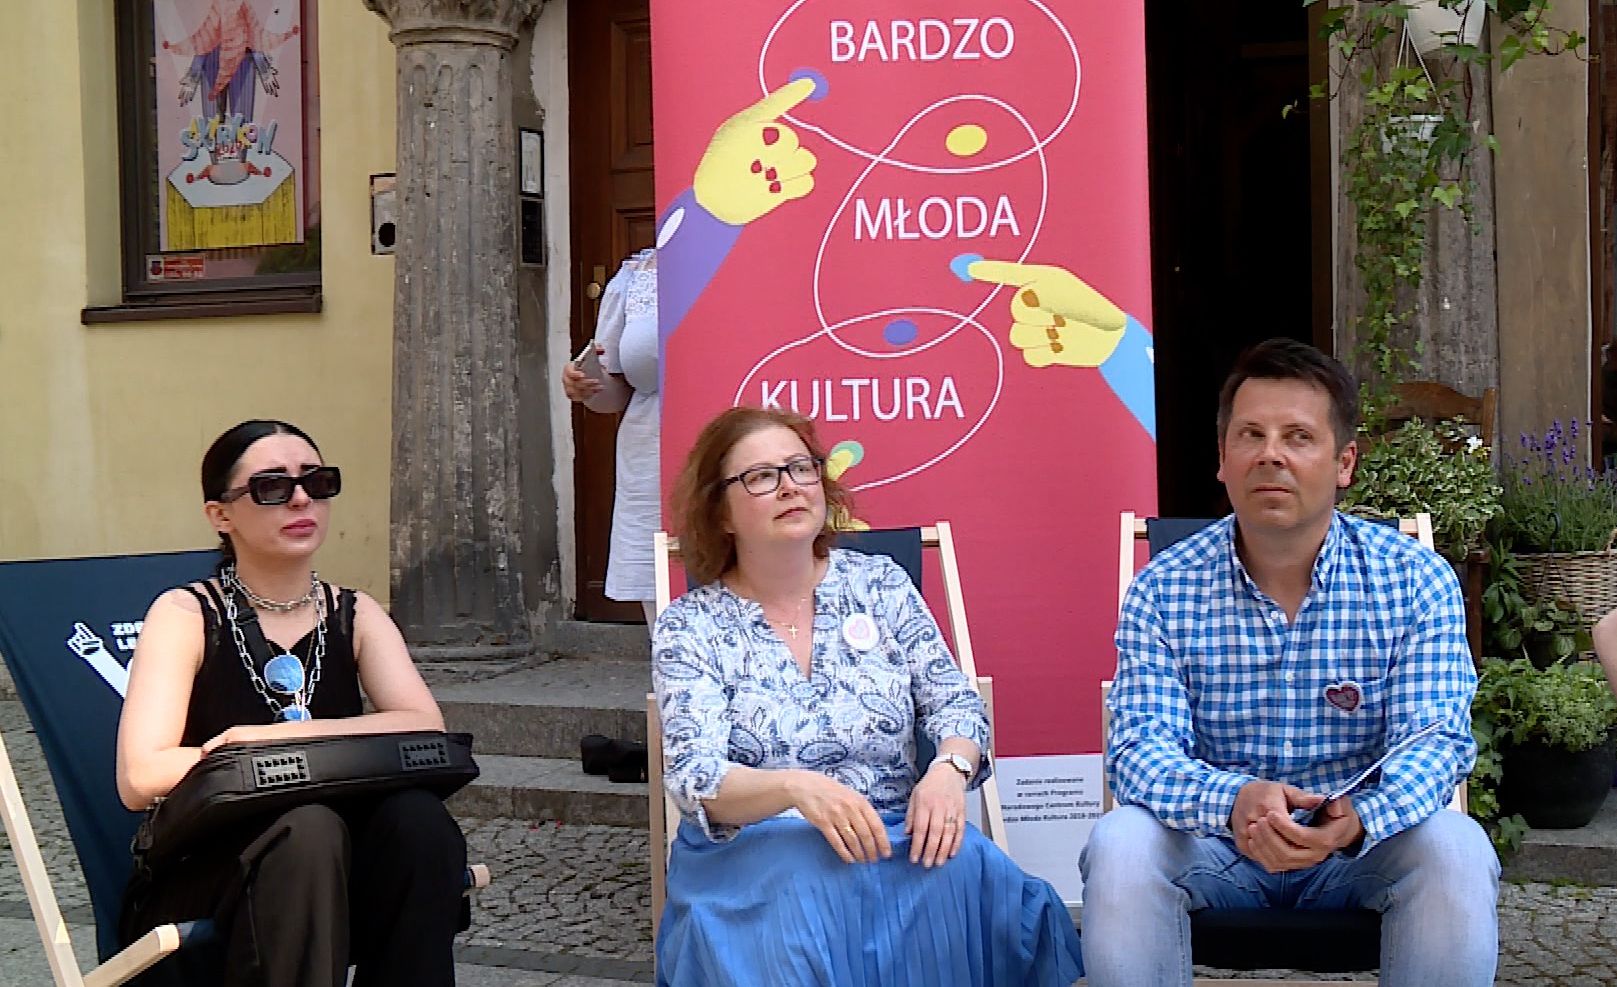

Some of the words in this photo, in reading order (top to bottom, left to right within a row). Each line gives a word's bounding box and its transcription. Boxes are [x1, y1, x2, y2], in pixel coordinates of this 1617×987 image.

[830, 17, 1015, 62] BARDZO
[854, 195, 1021, 241] MŁODA
[761, 376, 965, 422] KULTURA
